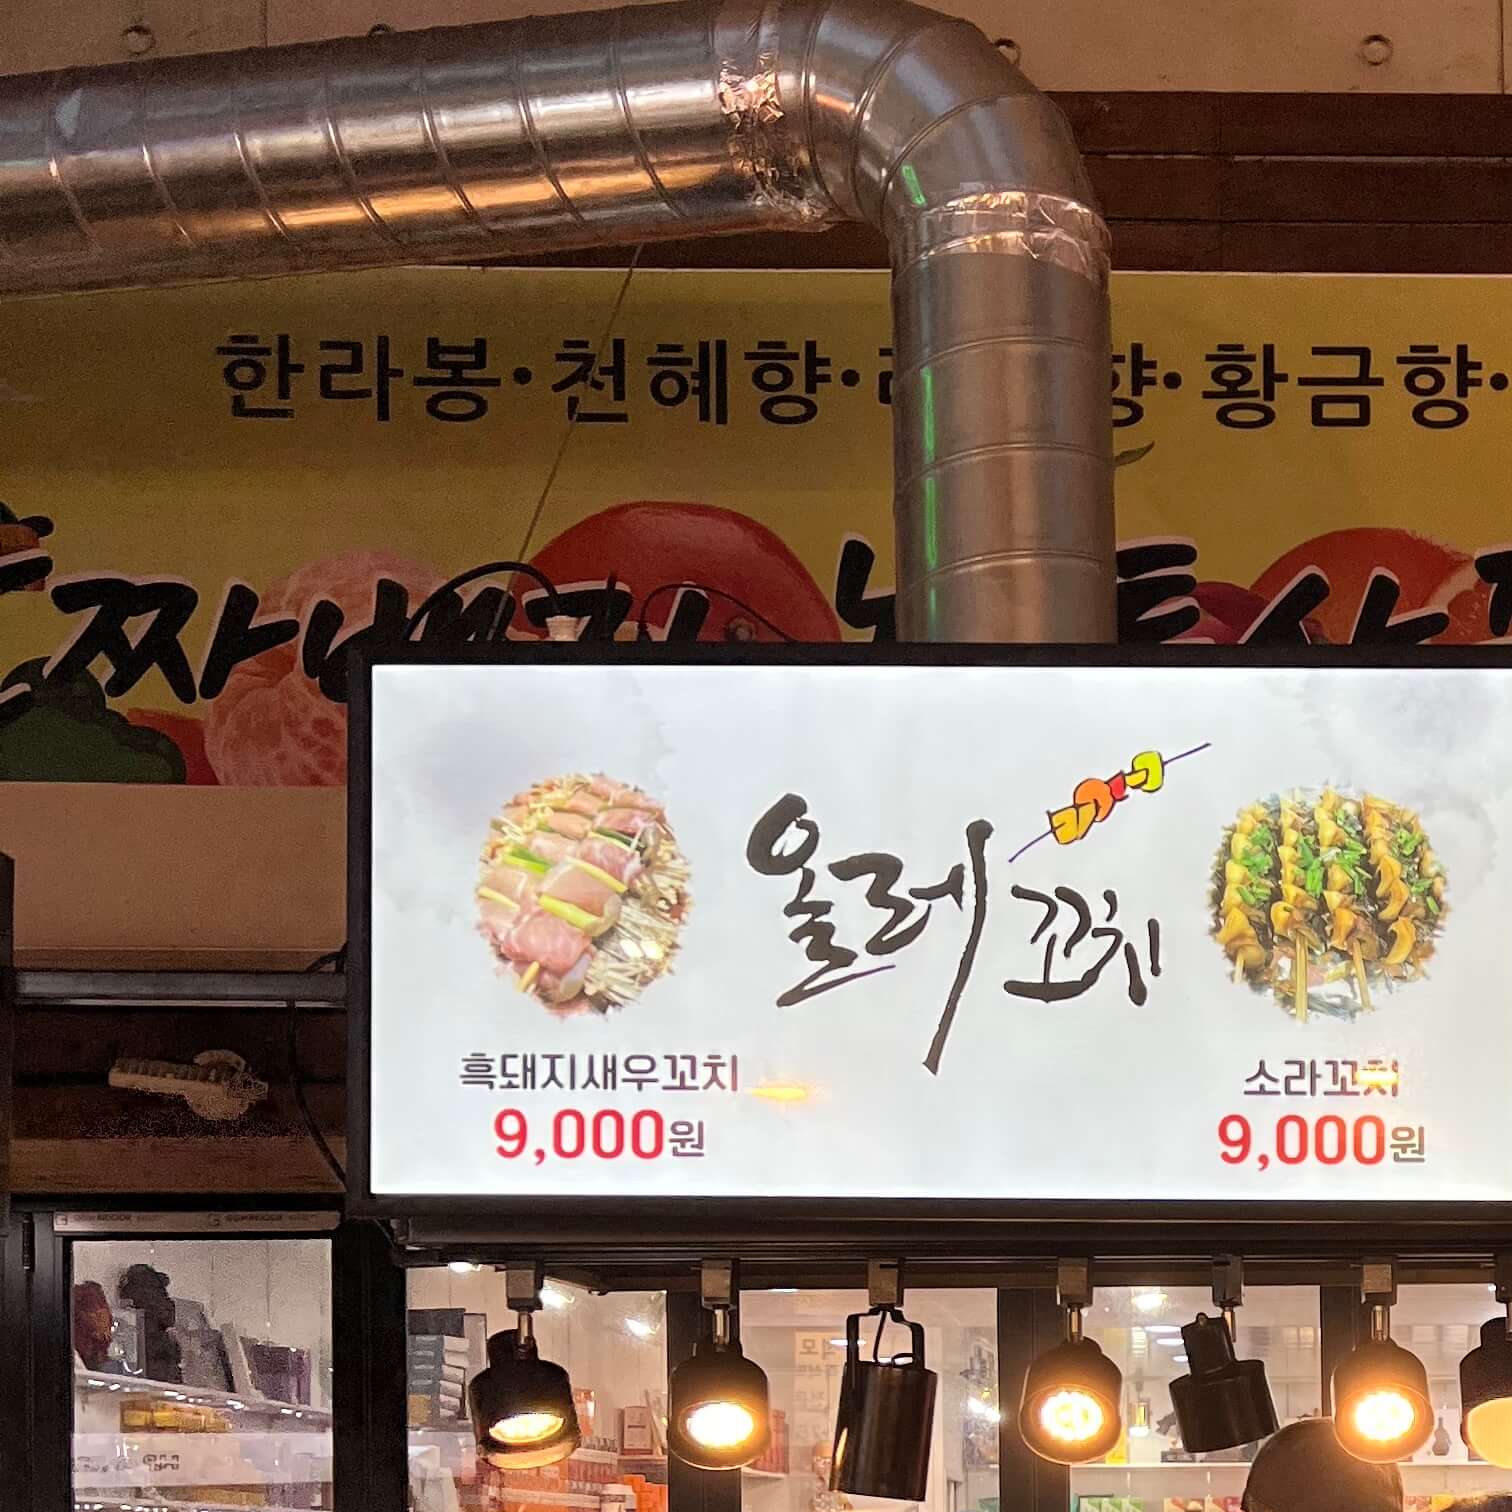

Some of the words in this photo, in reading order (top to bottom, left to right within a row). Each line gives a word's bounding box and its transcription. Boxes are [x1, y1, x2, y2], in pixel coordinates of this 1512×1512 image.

[745, 792, 994, 1076] 올레
[1002, 885, 1161, 1007] 꼬치
[459, 1053, 739, 1094] 흑돼지새우꼬치
[1242, 1058, 1400, 1099] 소라꼬치
[493, 1108, 706, 1162] 9,000원
[1217, 1113, 1426, 1166] 9,000원
